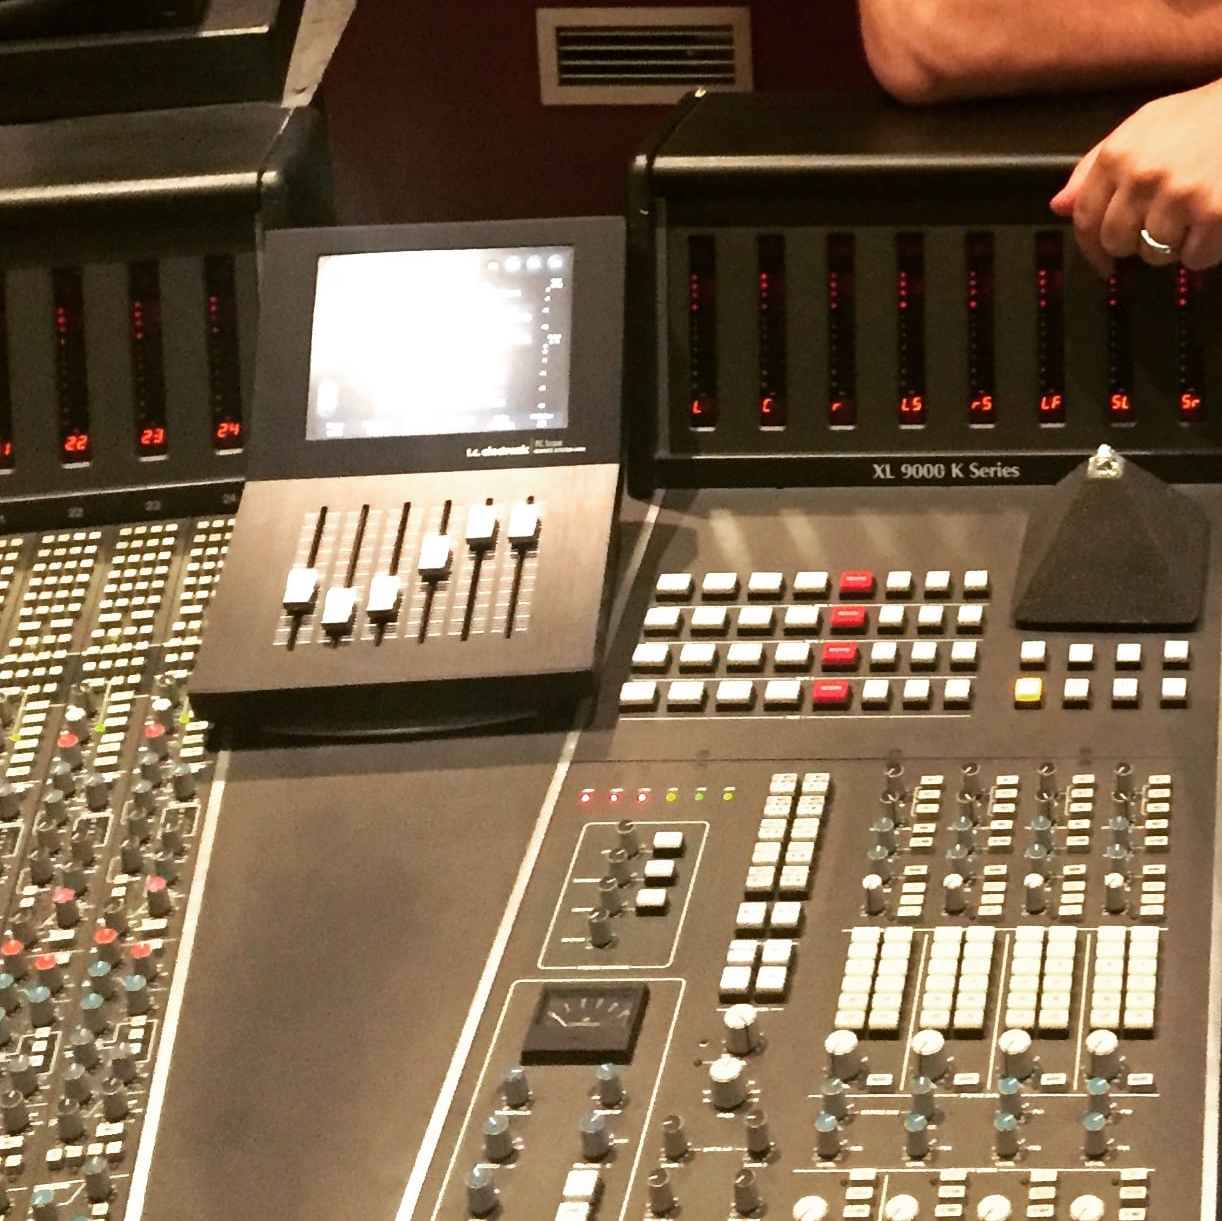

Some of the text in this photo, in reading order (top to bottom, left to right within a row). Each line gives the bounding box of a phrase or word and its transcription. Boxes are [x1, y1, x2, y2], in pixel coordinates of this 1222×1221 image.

[692, 400, 702, 414] L
[1040, 395, 1062, 410] LF
[1111, 394, 1130, 409] SL
[140, 428, 165, 445] 23
[216, 423, 241, 439] 24
[64, 434, 88, 451] 22
[873, 462, 1020, 479] XL 9000 K Series
